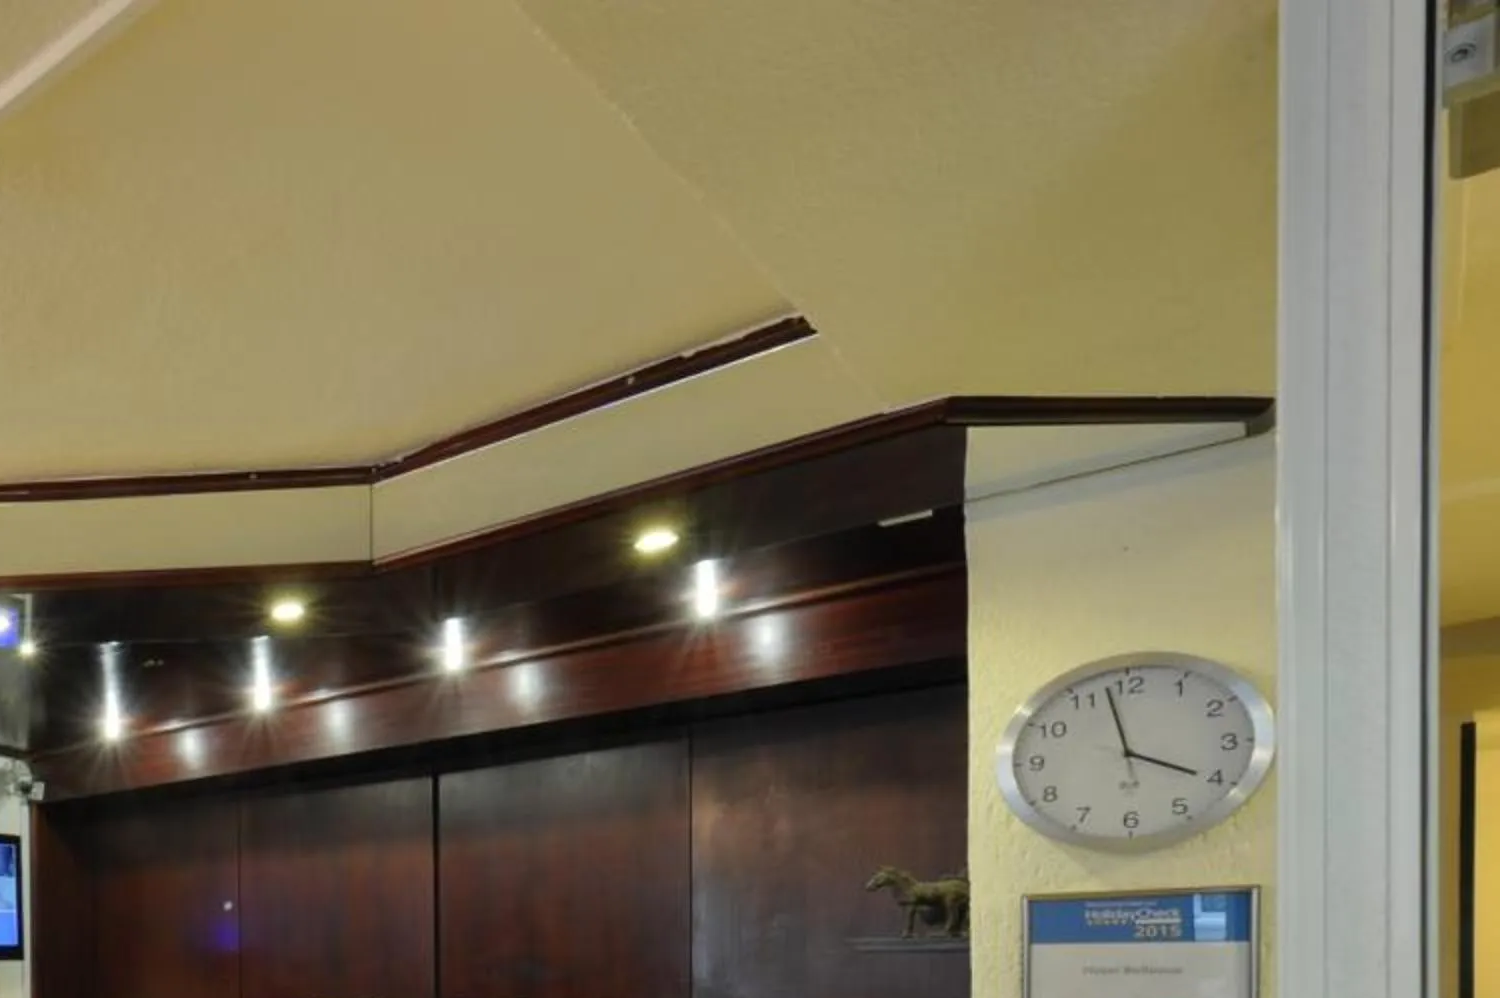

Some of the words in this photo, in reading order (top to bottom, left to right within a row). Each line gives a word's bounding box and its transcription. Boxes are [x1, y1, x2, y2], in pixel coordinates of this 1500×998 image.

[1114, 676, 1145, 695] 12
[1174, 679, 1185, 697] 1
[1071, 693, 1096, 710] 11
[1206, 699, 1224, 717] 2
[1039, 720, 1067, 738] 10
[1220, 732, 1238, 751] 3
[1028, 755, 1045, 772] 9
[1206, 769, 1224, 786] 4
[1042, 785, 1058, 802] 8
[1076, 806, 1091, 824] 7
[1171, 797, 1189, 816] 5
[1122, 811, 1139, 829] 6
[1133, 924, 1182, 938] 2015
